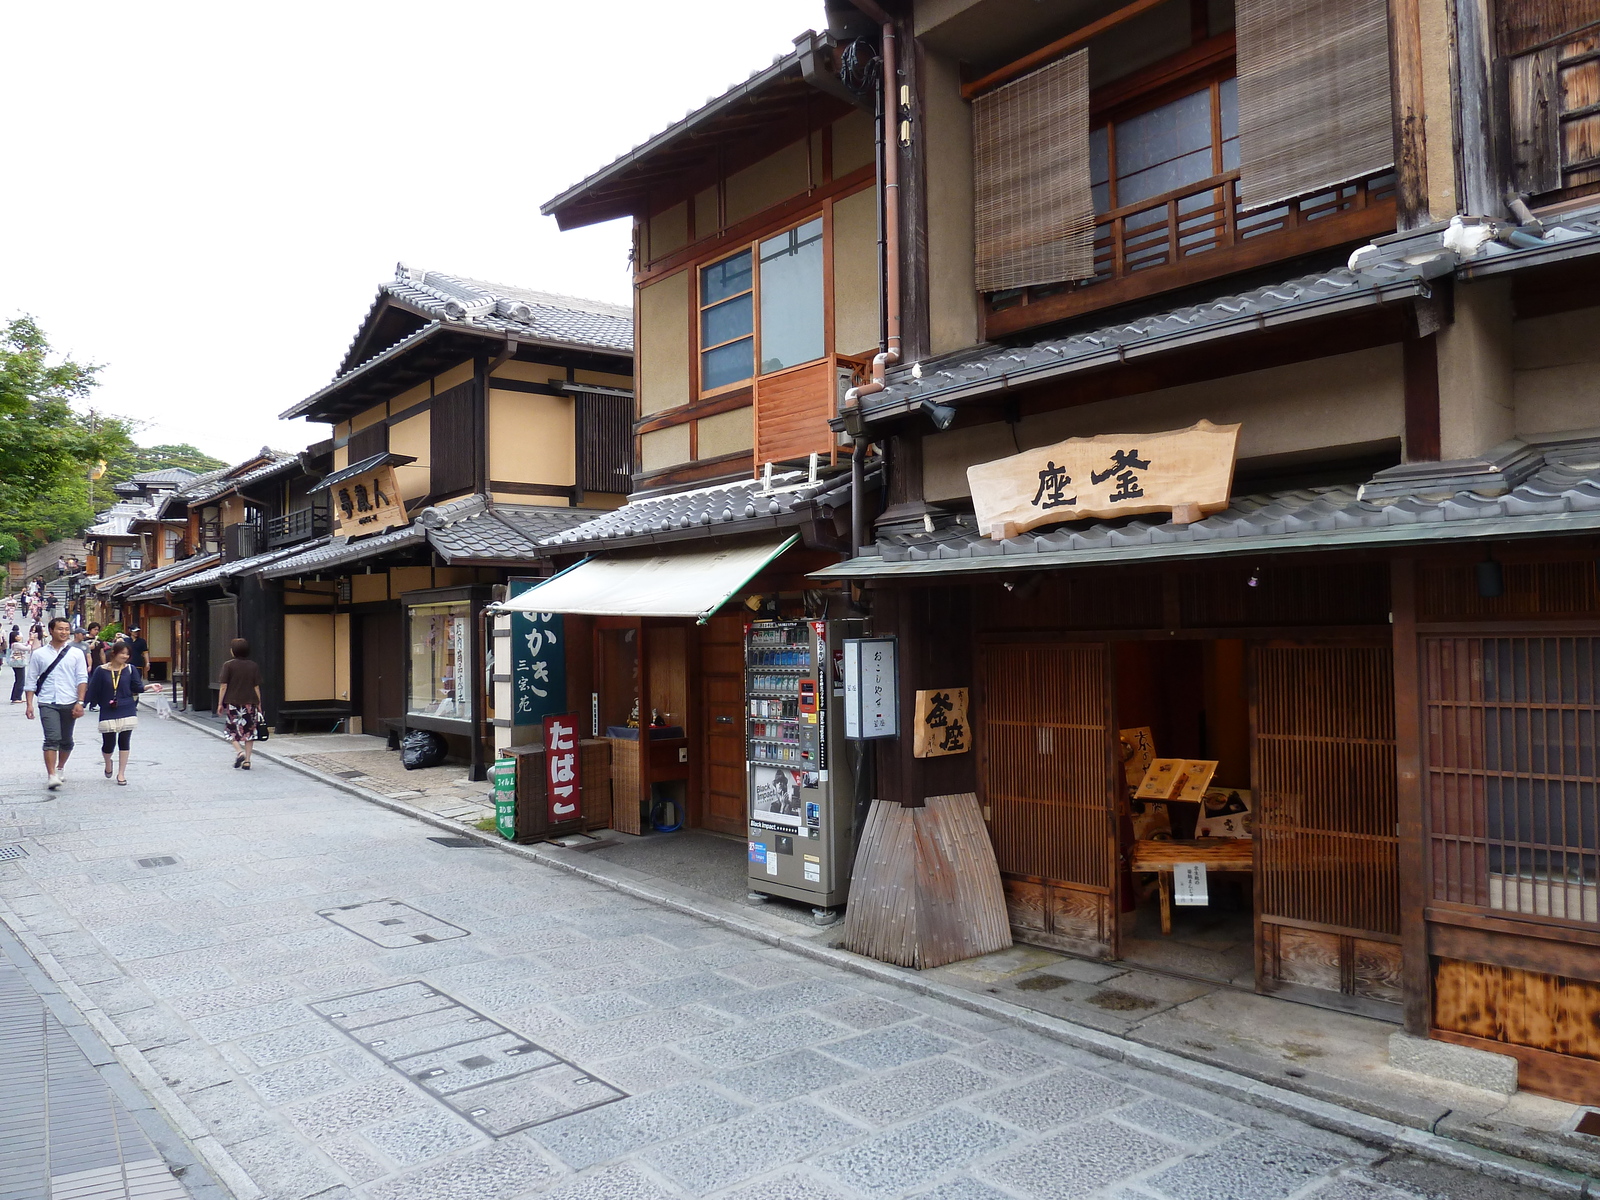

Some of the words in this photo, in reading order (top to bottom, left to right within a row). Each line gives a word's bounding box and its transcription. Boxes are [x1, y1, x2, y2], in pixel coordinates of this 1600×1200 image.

[925, 692, 964, 751] 釜座
[549, 721, 575, 814] たばこ
[757, 783, 771, 794] Black
